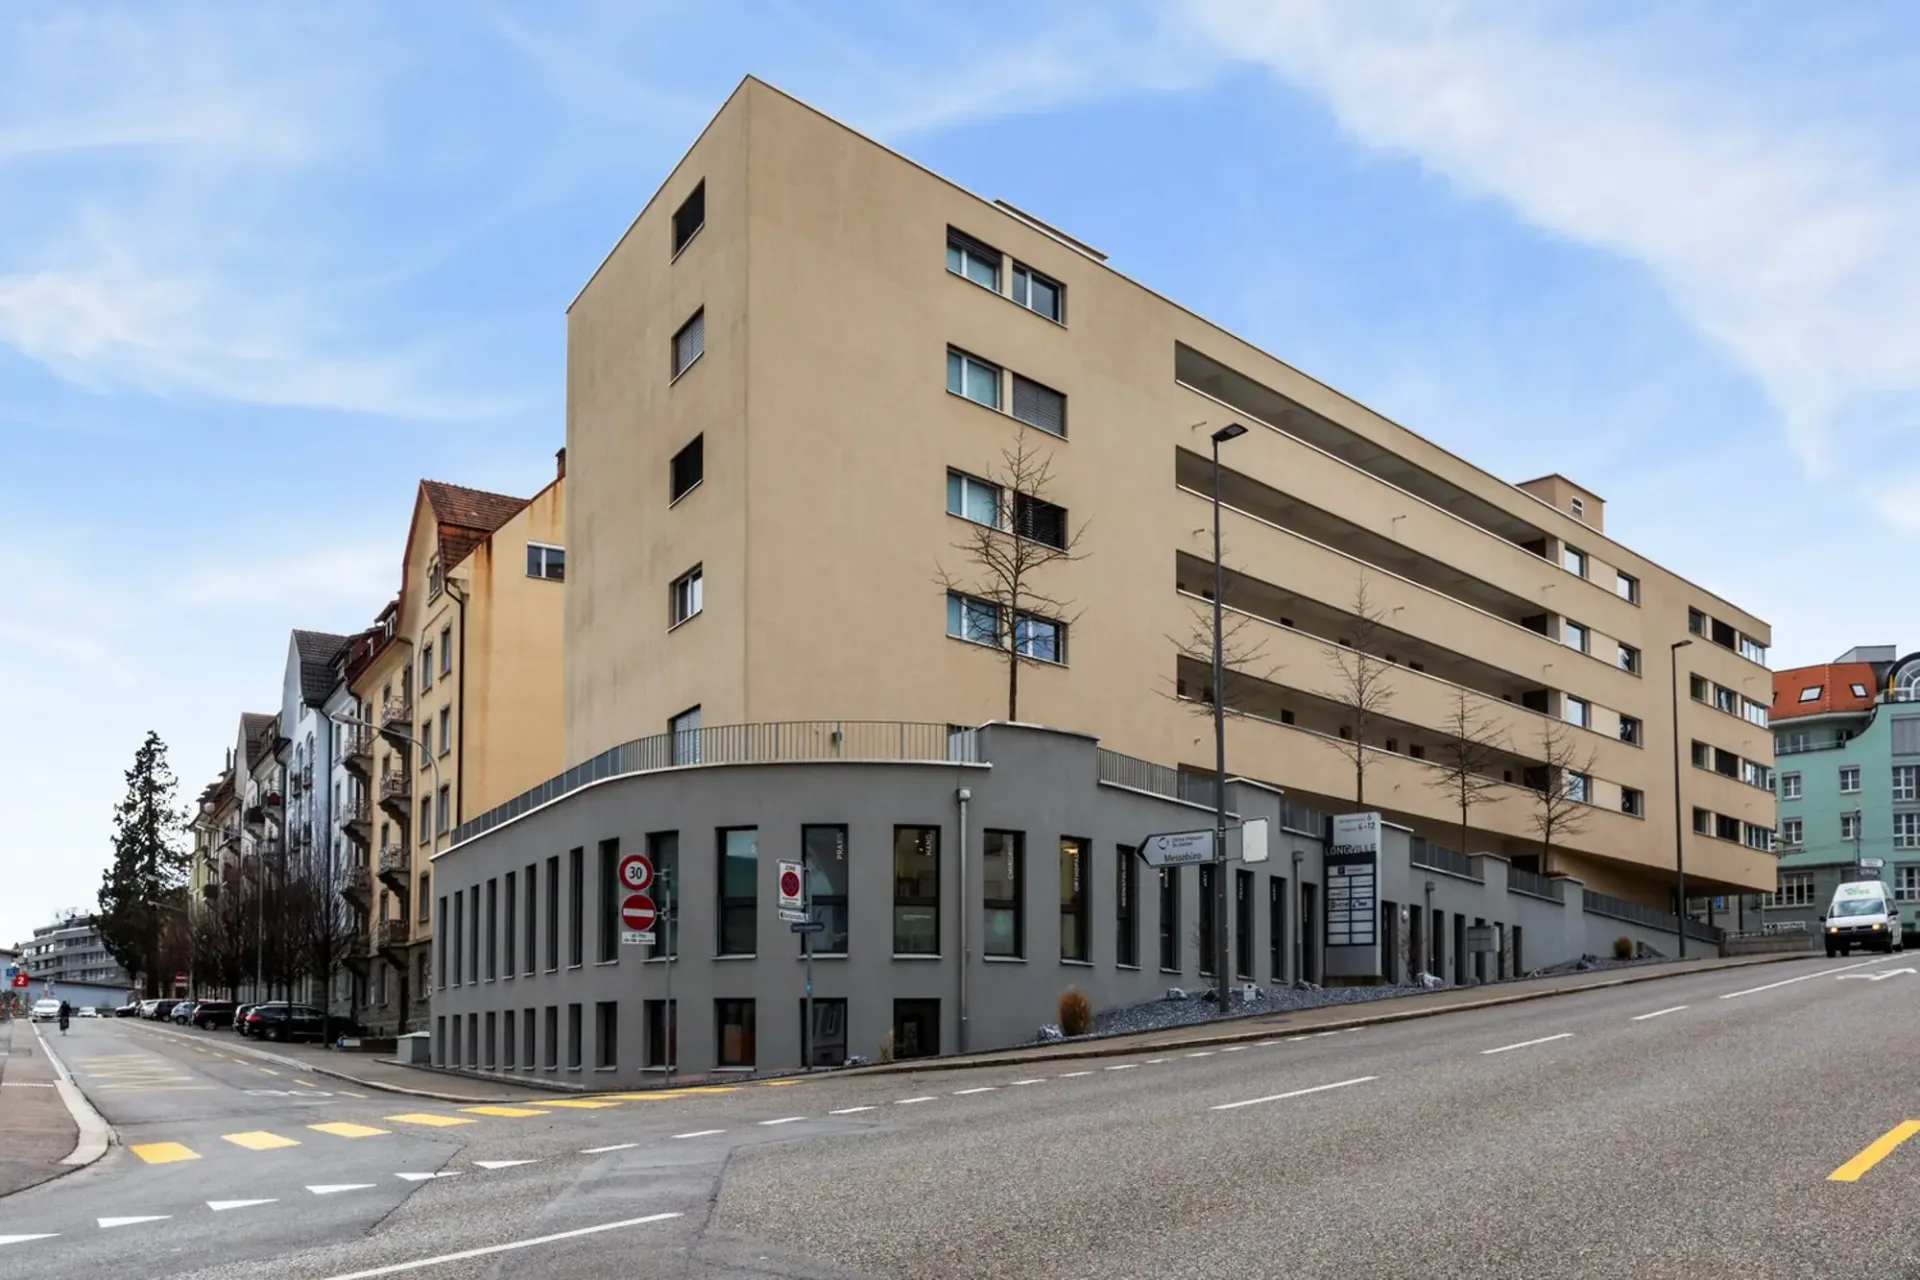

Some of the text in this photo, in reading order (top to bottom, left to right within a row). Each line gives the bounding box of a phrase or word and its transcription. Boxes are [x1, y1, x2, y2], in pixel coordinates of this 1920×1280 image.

[836, 832, 844, 860] PRAXIS
[1325, 843, 1376, 856] LONGVILLE
[1164, 852, 1202, 862] Messebüro
[629, 866, 643, 880] 30
[17, 976, 25, 985] 2
